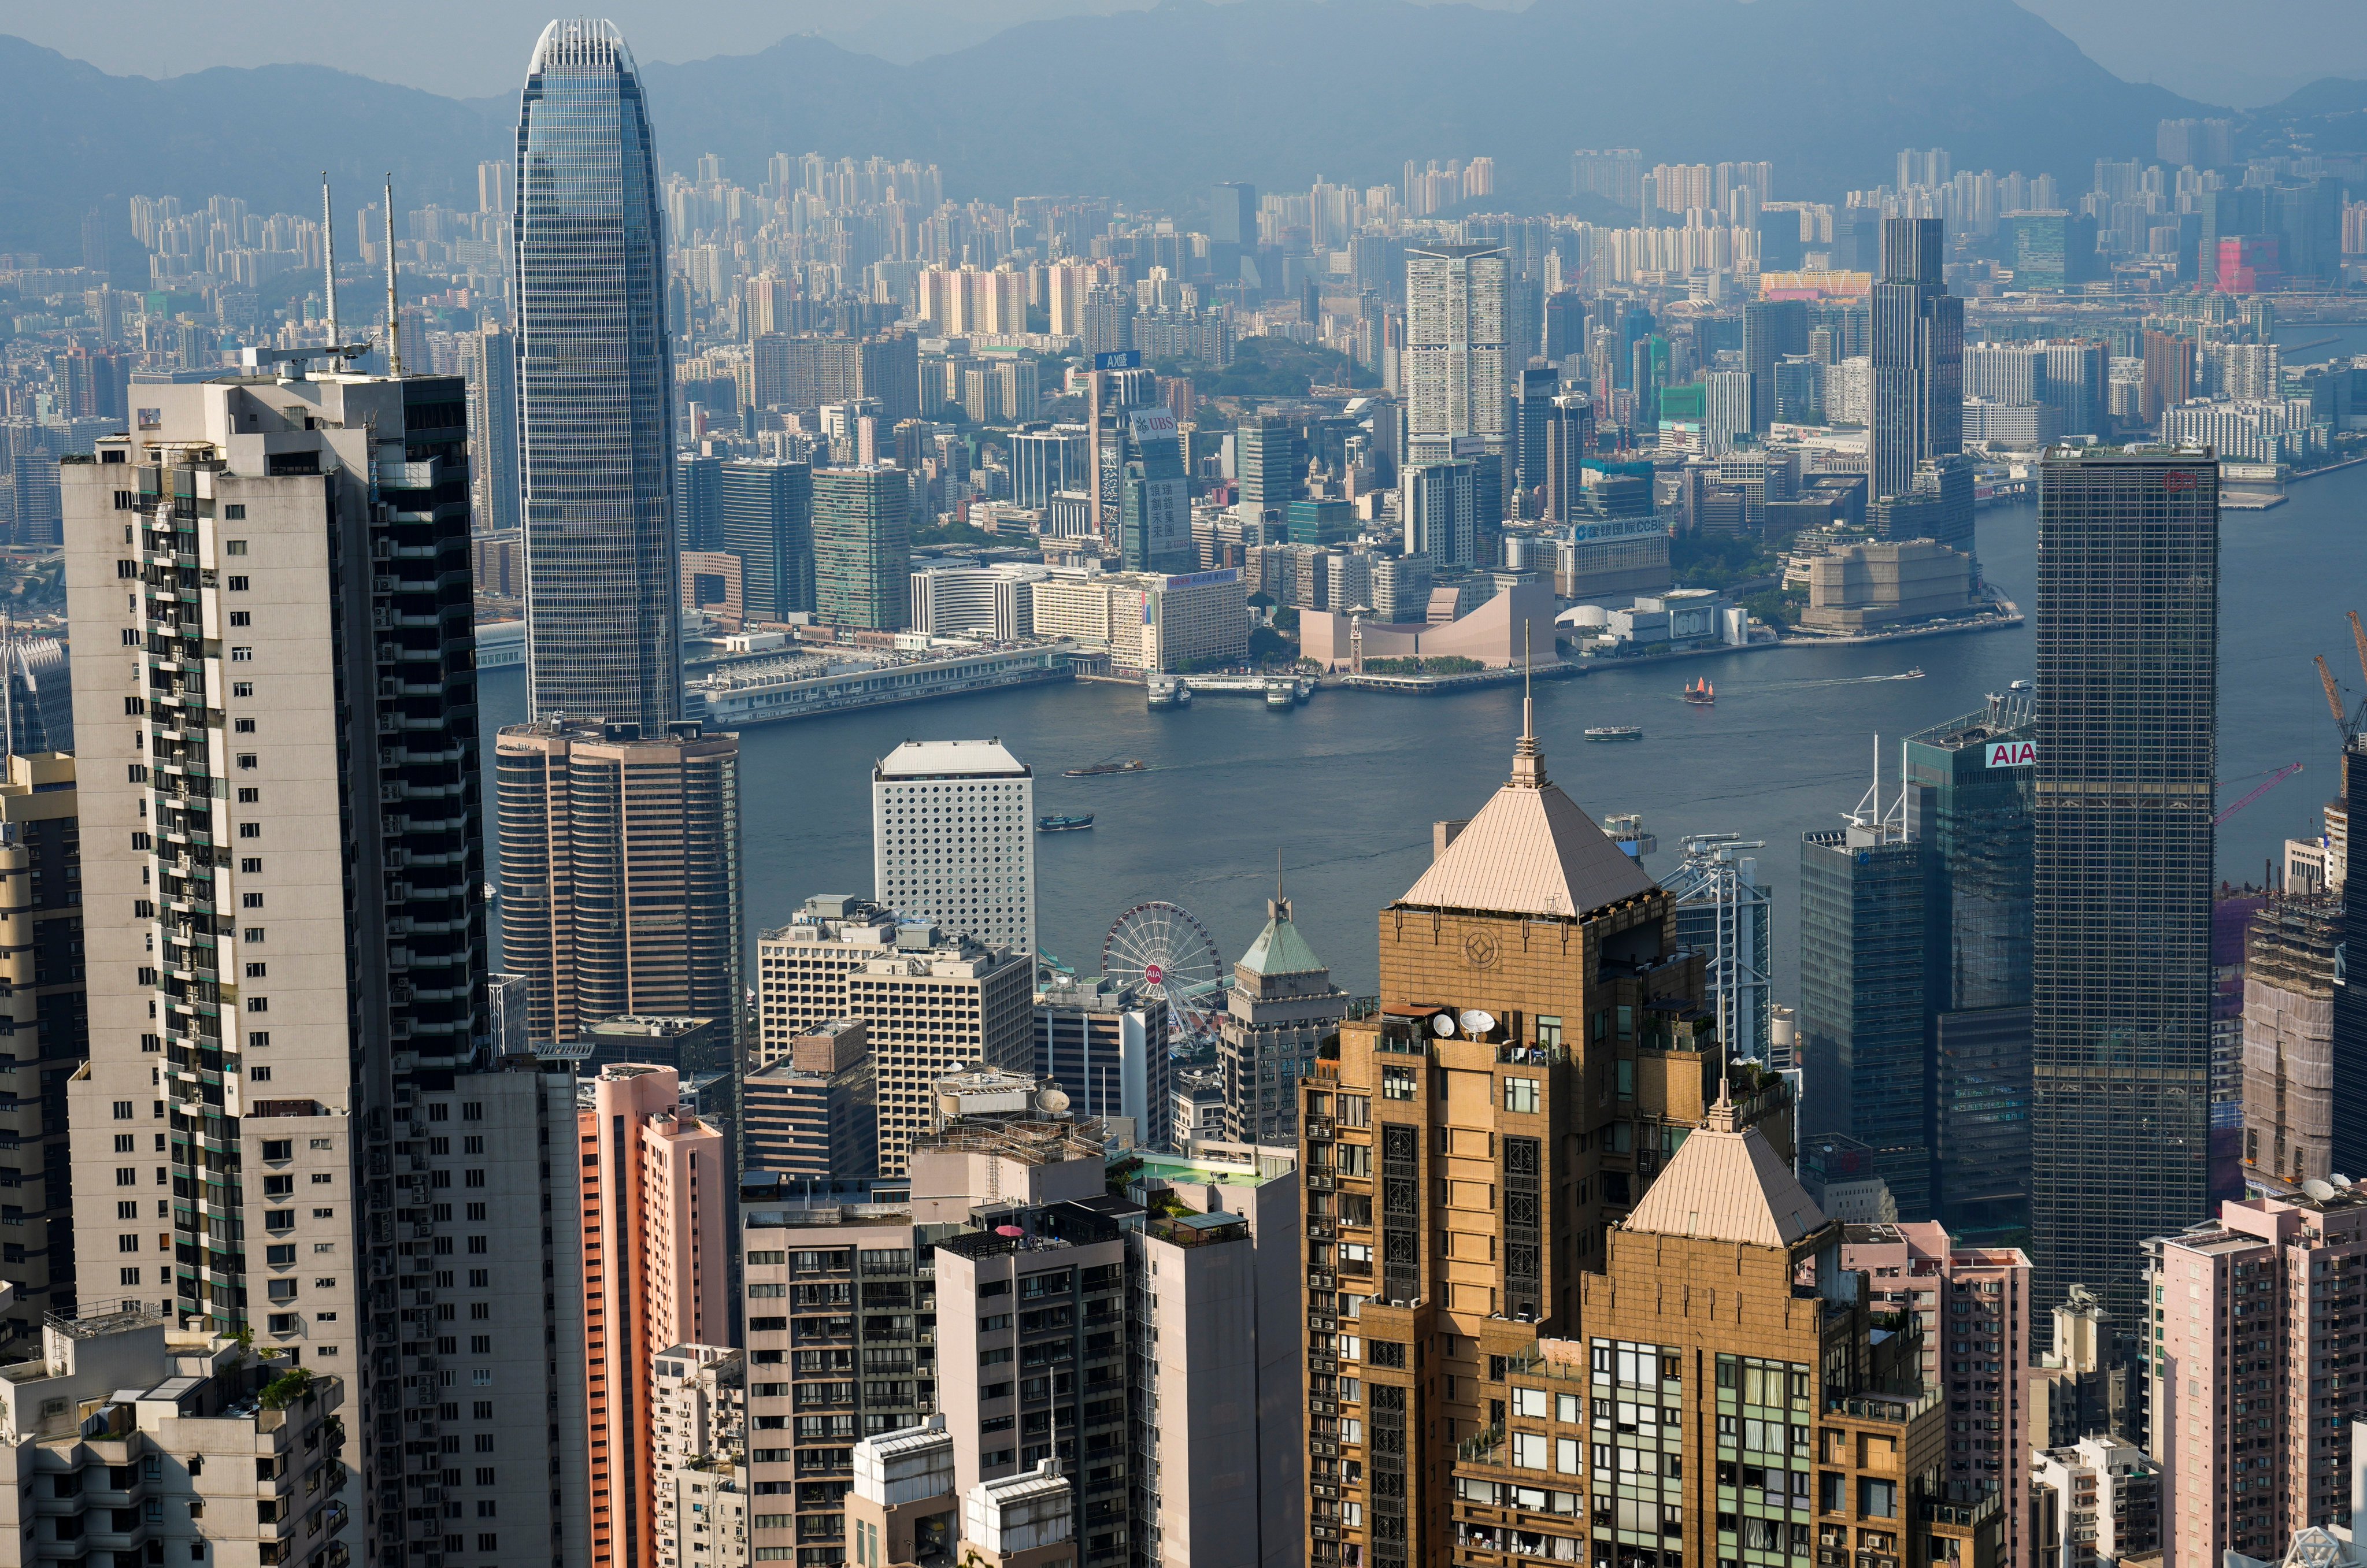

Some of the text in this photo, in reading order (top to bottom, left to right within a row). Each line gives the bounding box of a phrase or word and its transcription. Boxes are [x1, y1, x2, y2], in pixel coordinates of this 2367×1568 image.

[1149, 416, 1173, 431] UBS
[1150, 484, 1162, 538] 領創未來
[1162, 483, 1175, 537] 瑞銀集團
[1174, 539, 1188, 548] UBS
[1991, 743, 2036, 765] AIA
[1147, 970, 1161, 978] AIA
